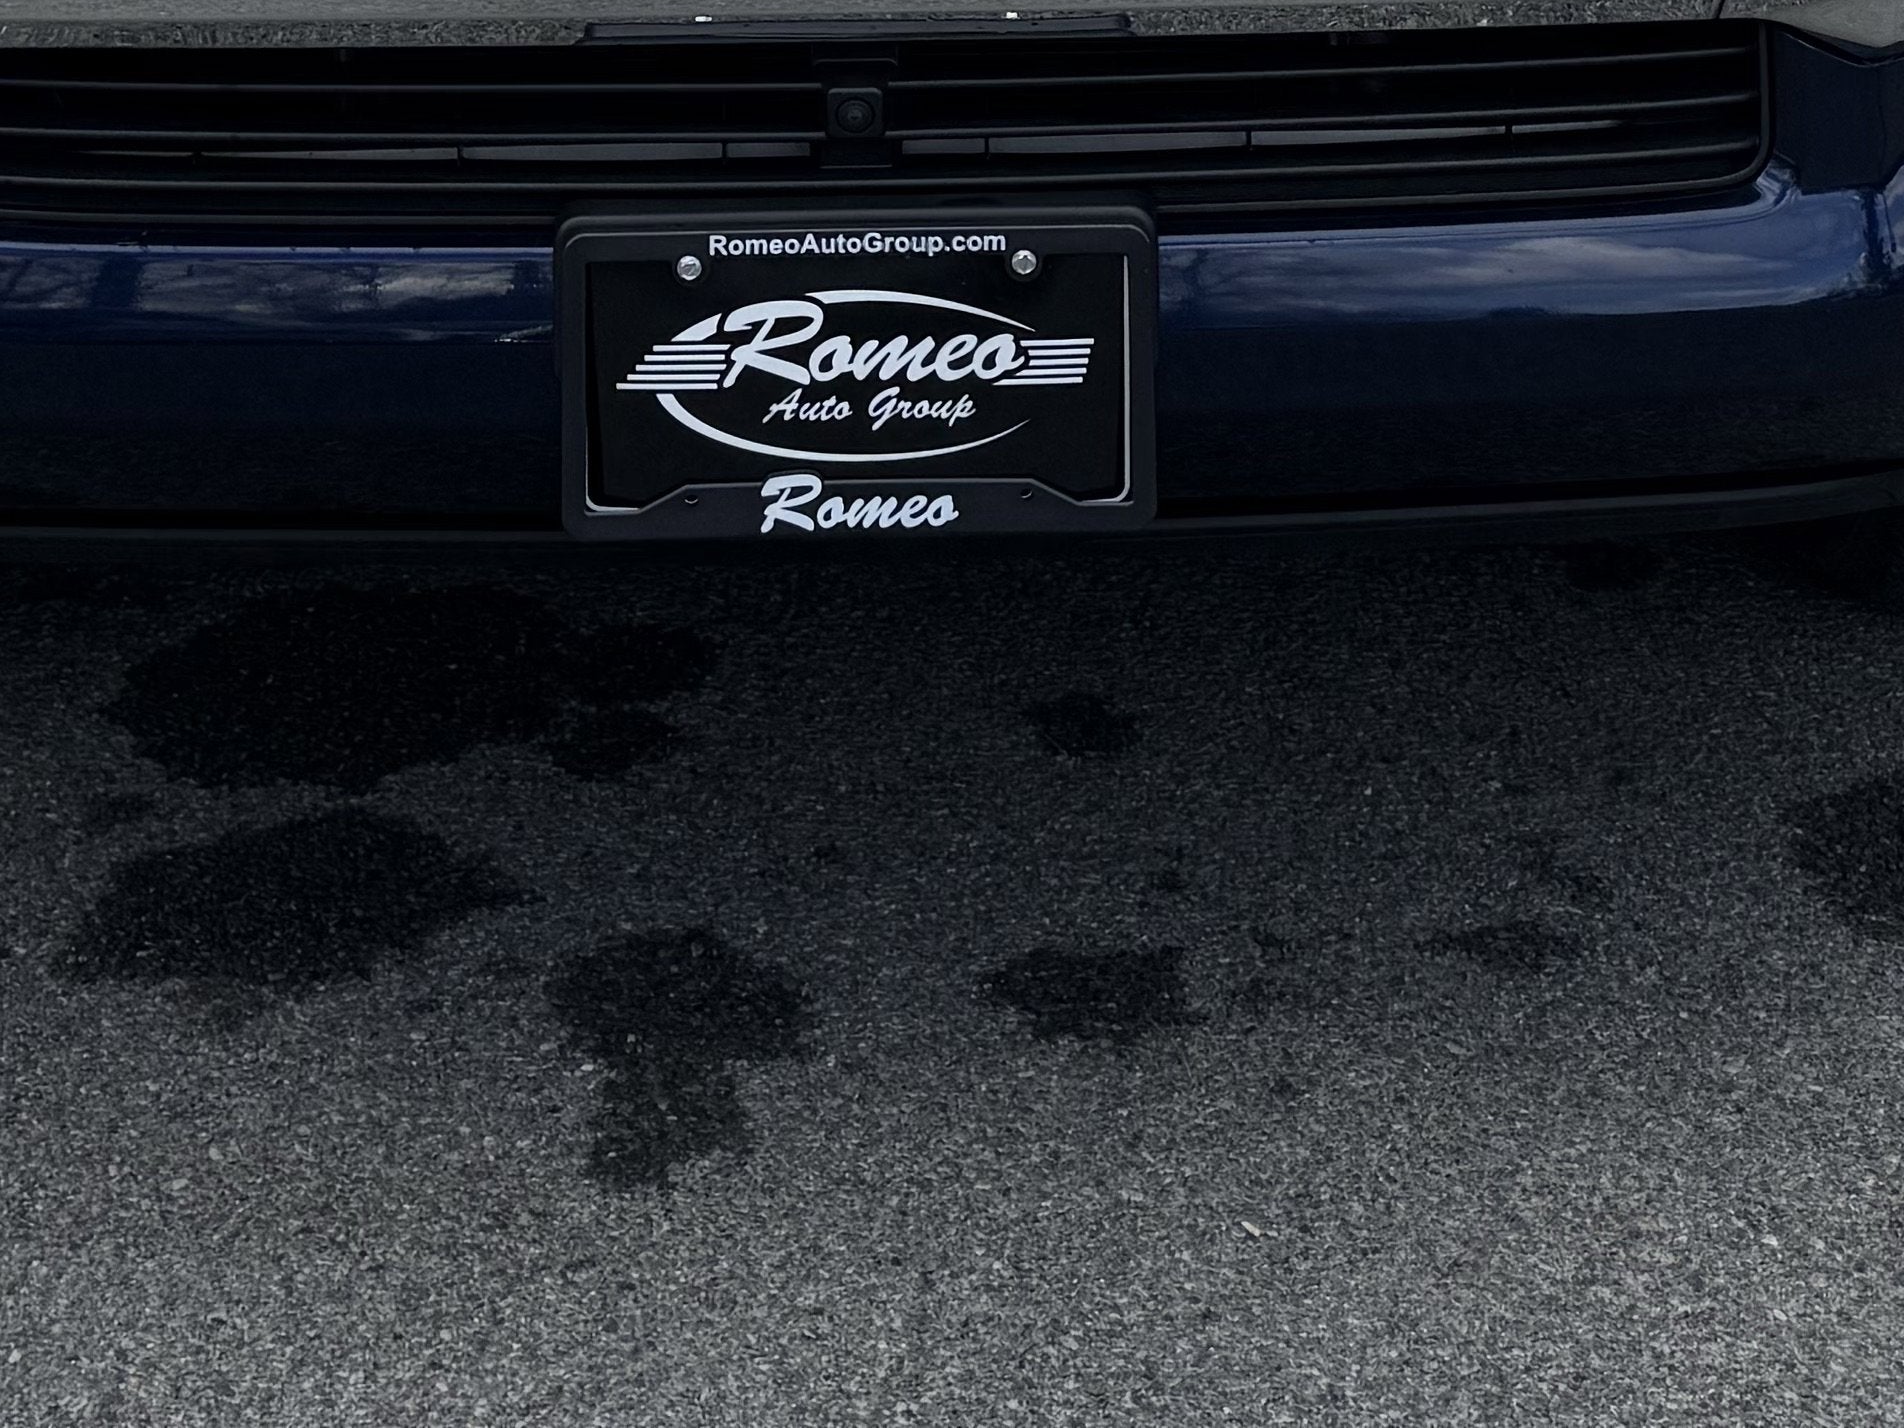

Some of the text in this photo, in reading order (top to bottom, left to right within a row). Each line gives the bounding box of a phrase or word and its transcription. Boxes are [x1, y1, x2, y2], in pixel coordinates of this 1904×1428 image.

[708, 231, 1006, 257] RomeoAutoGroup.com
[723, 299, 1028, 390] Romeo
[762, 387, 976, 431] Auto Group
[760, 473, 959, 534] Romeo
